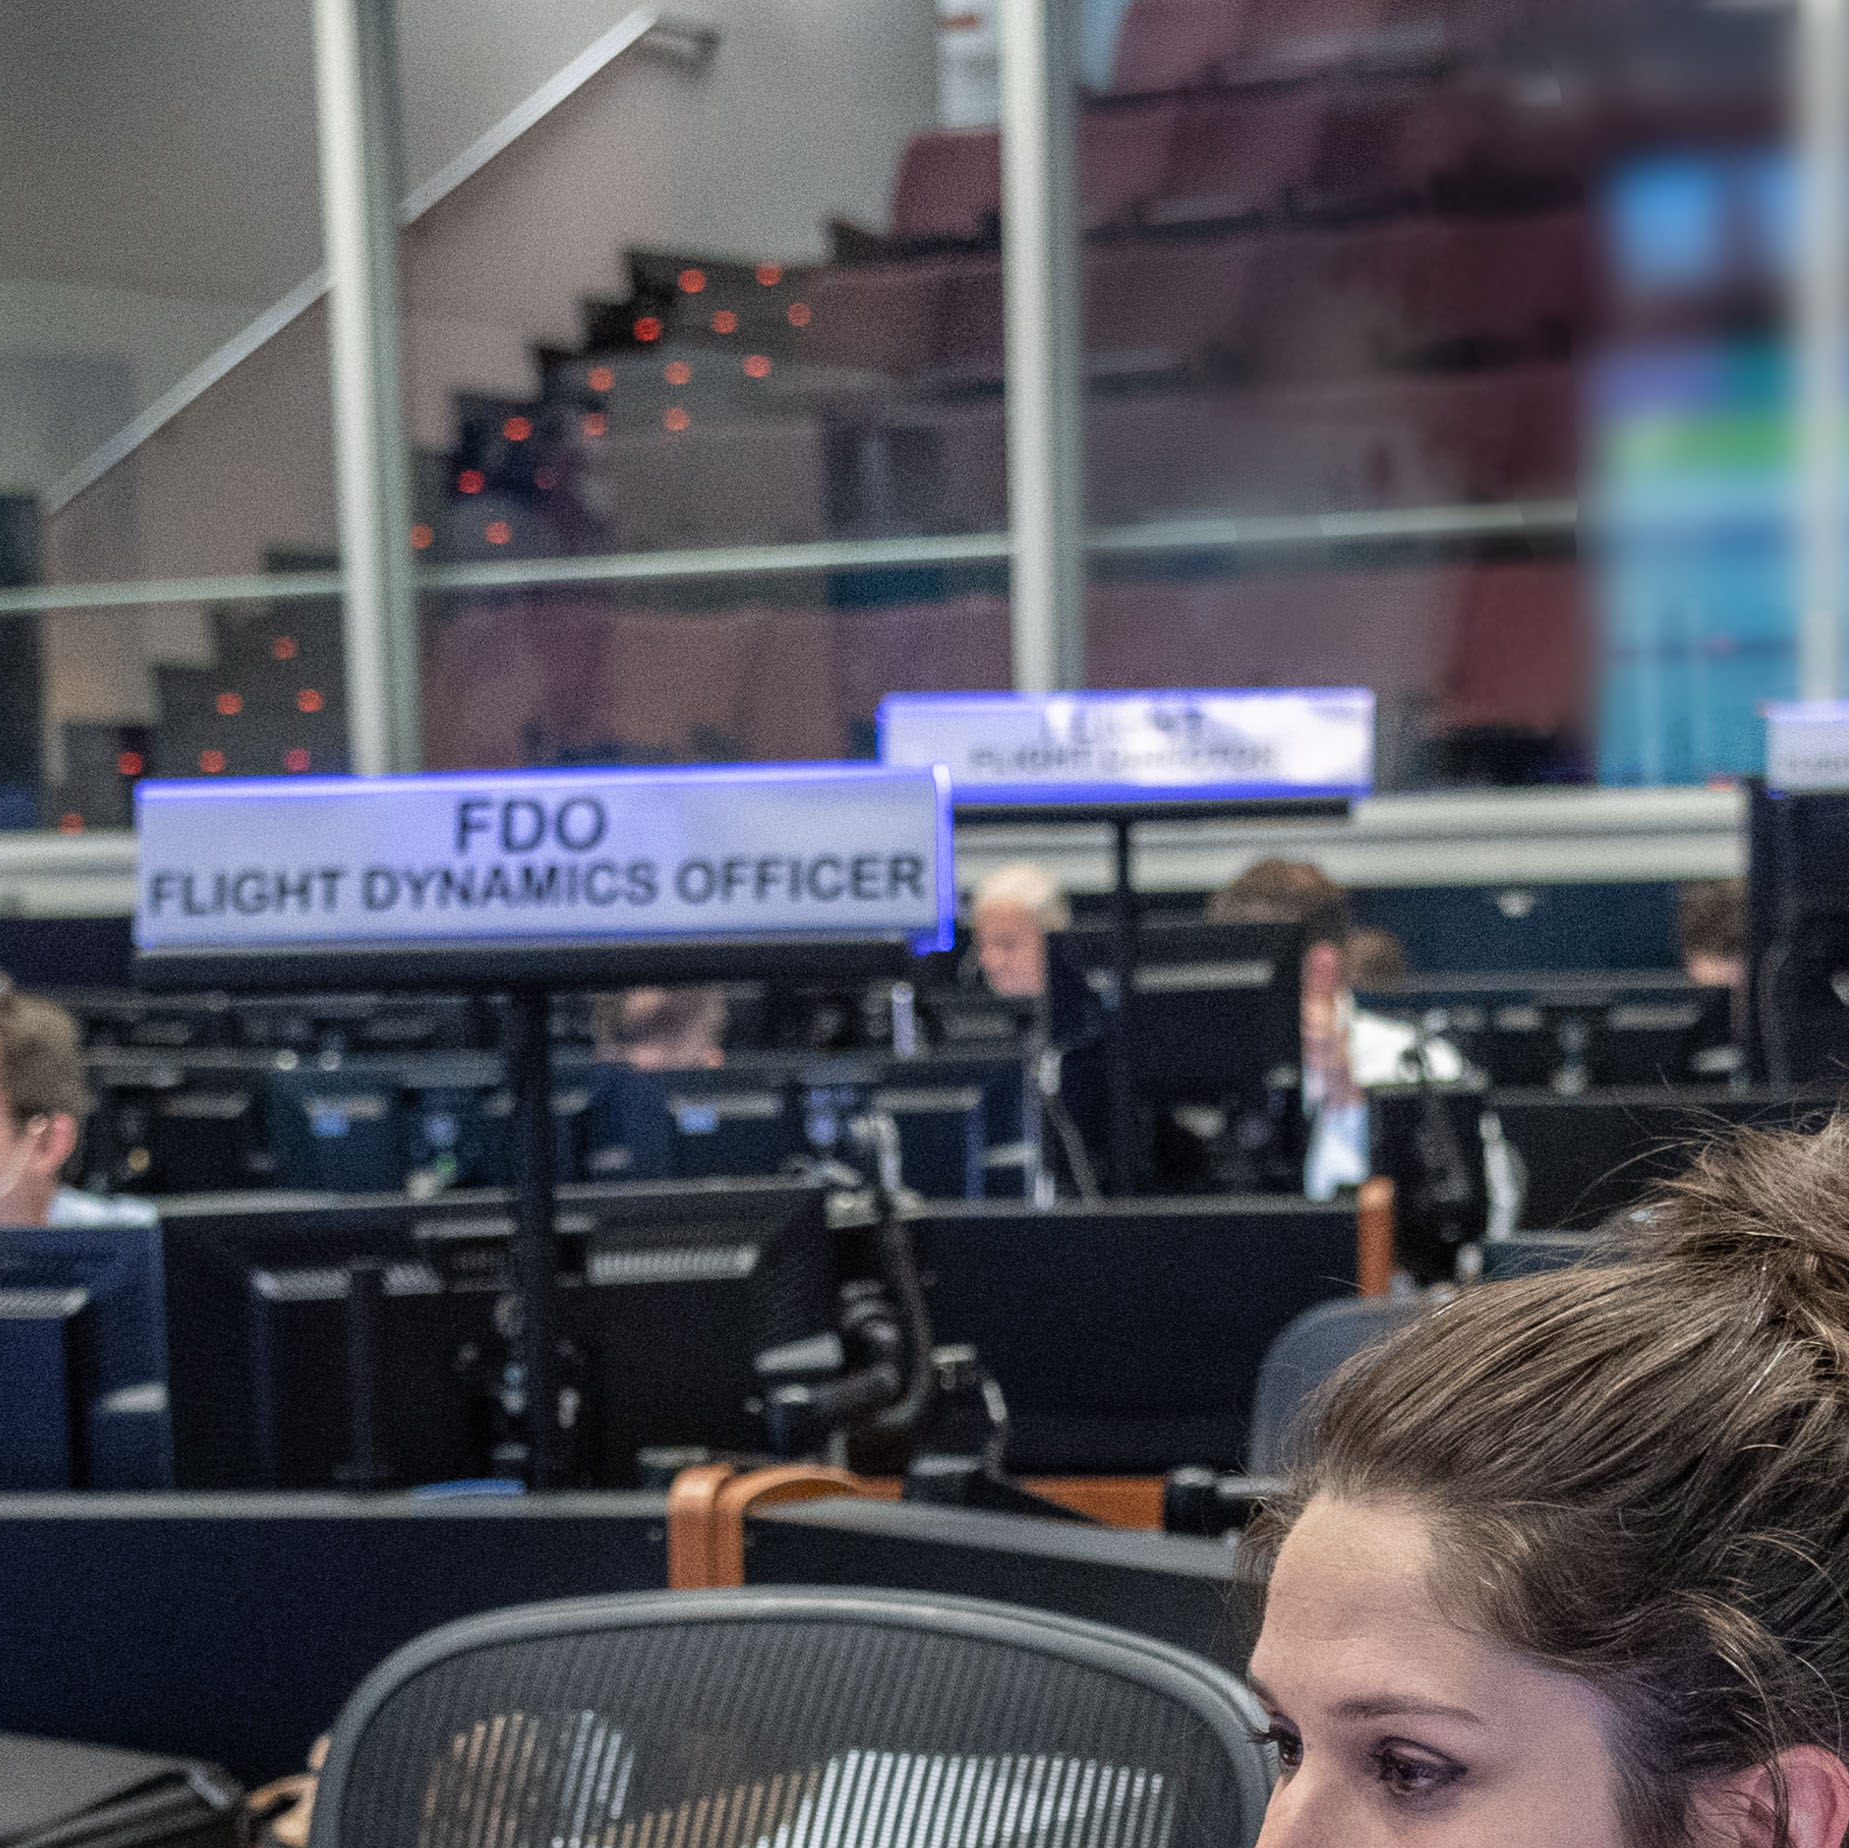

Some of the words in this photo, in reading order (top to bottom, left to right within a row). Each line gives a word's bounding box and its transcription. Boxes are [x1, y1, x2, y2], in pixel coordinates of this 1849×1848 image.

[455, 797, 607, 855] FDO
[150, 861, 349, 918] FLIGHT
[363, 856, 658, 914] DYNAMICS
[673, 850, 926, 906] OFFICER
